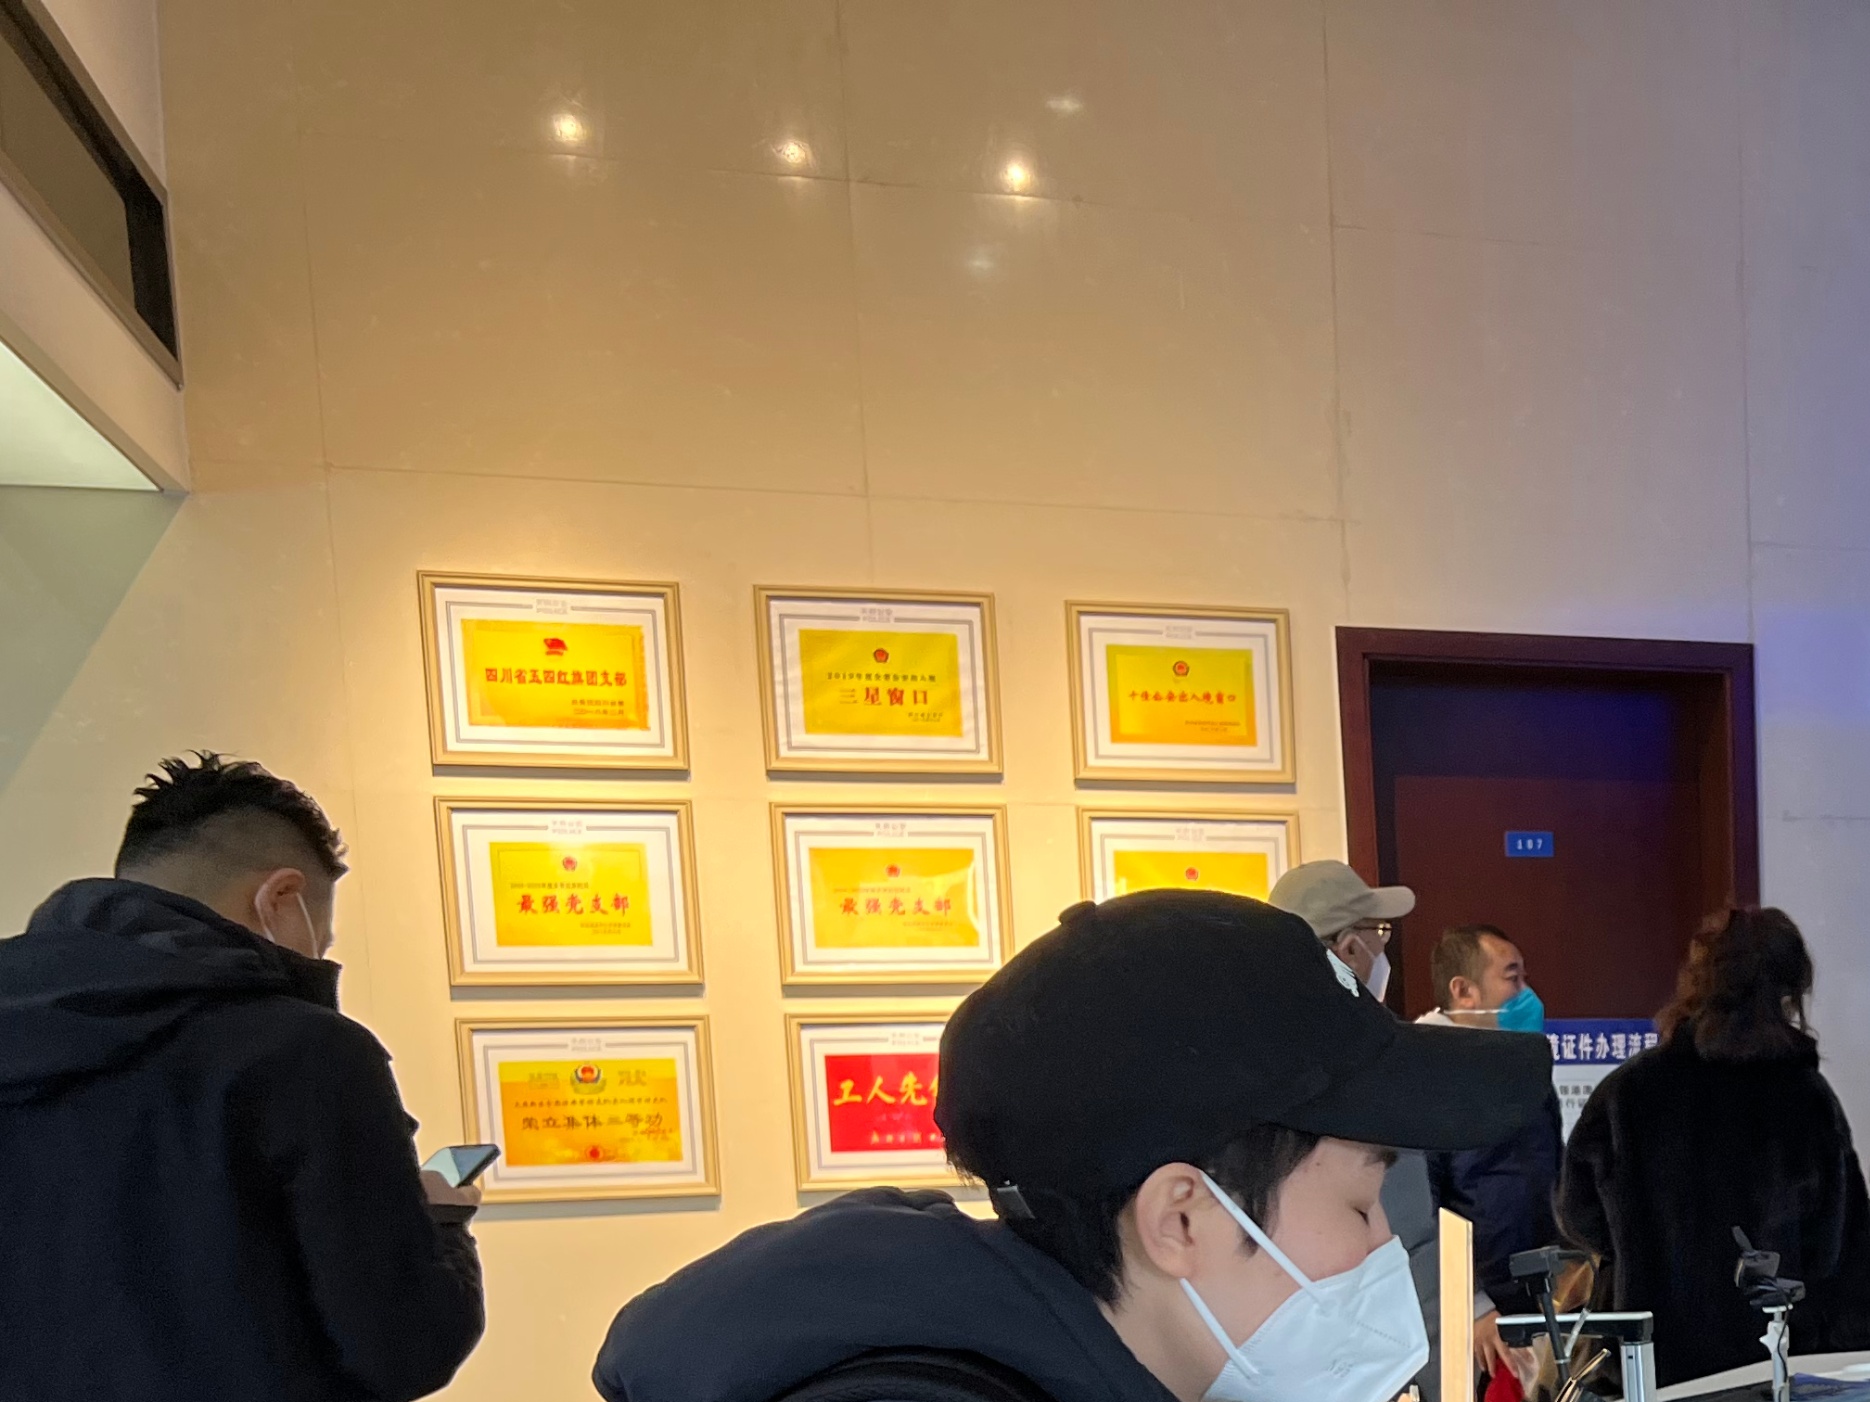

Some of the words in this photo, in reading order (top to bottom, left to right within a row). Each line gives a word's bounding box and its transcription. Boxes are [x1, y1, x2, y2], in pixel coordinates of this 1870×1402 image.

[839, 686, 929, 706] 三星窗口
[1516, 838, 1543, 850] 107
[516, 892, 630, 917] 最强党支部
[840, 896, 952, 917] 最强党支部
